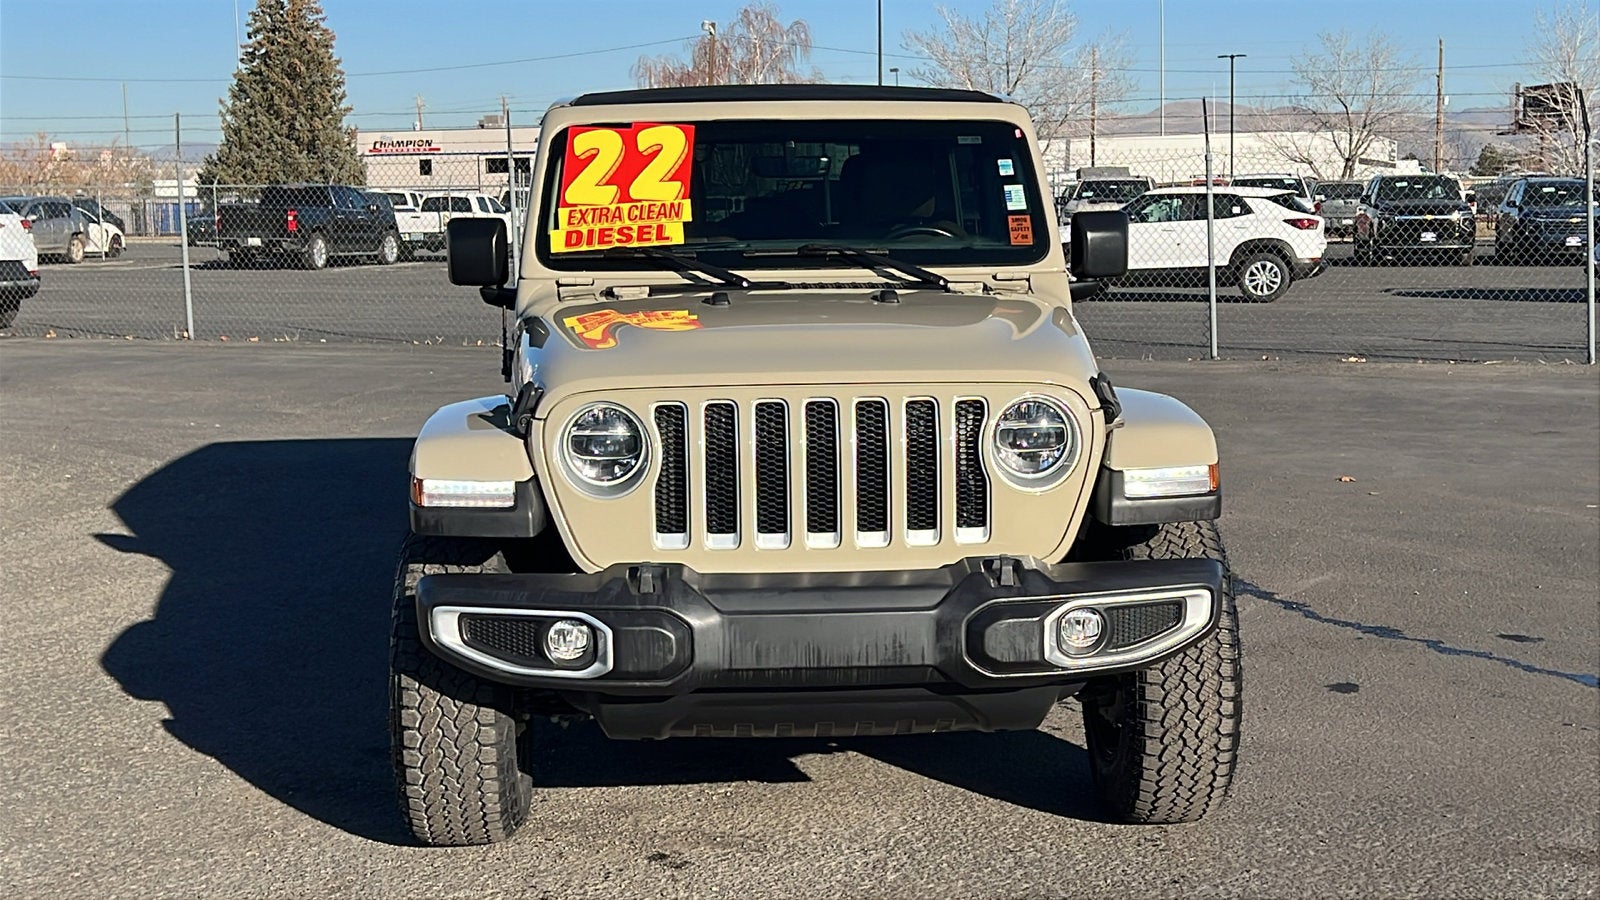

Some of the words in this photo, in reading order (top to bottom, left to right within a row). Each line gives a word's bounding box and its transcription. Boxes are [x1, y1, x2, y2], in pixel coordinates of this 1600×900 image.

[373, 139, 433, 149] CHAMPION
[564, 125, 688, 204] 22
[567, 205, 622, 226] EXTRA
[627, 202, 684, 222] CLEAN
[564, 224, 671, 249] DIESEL
